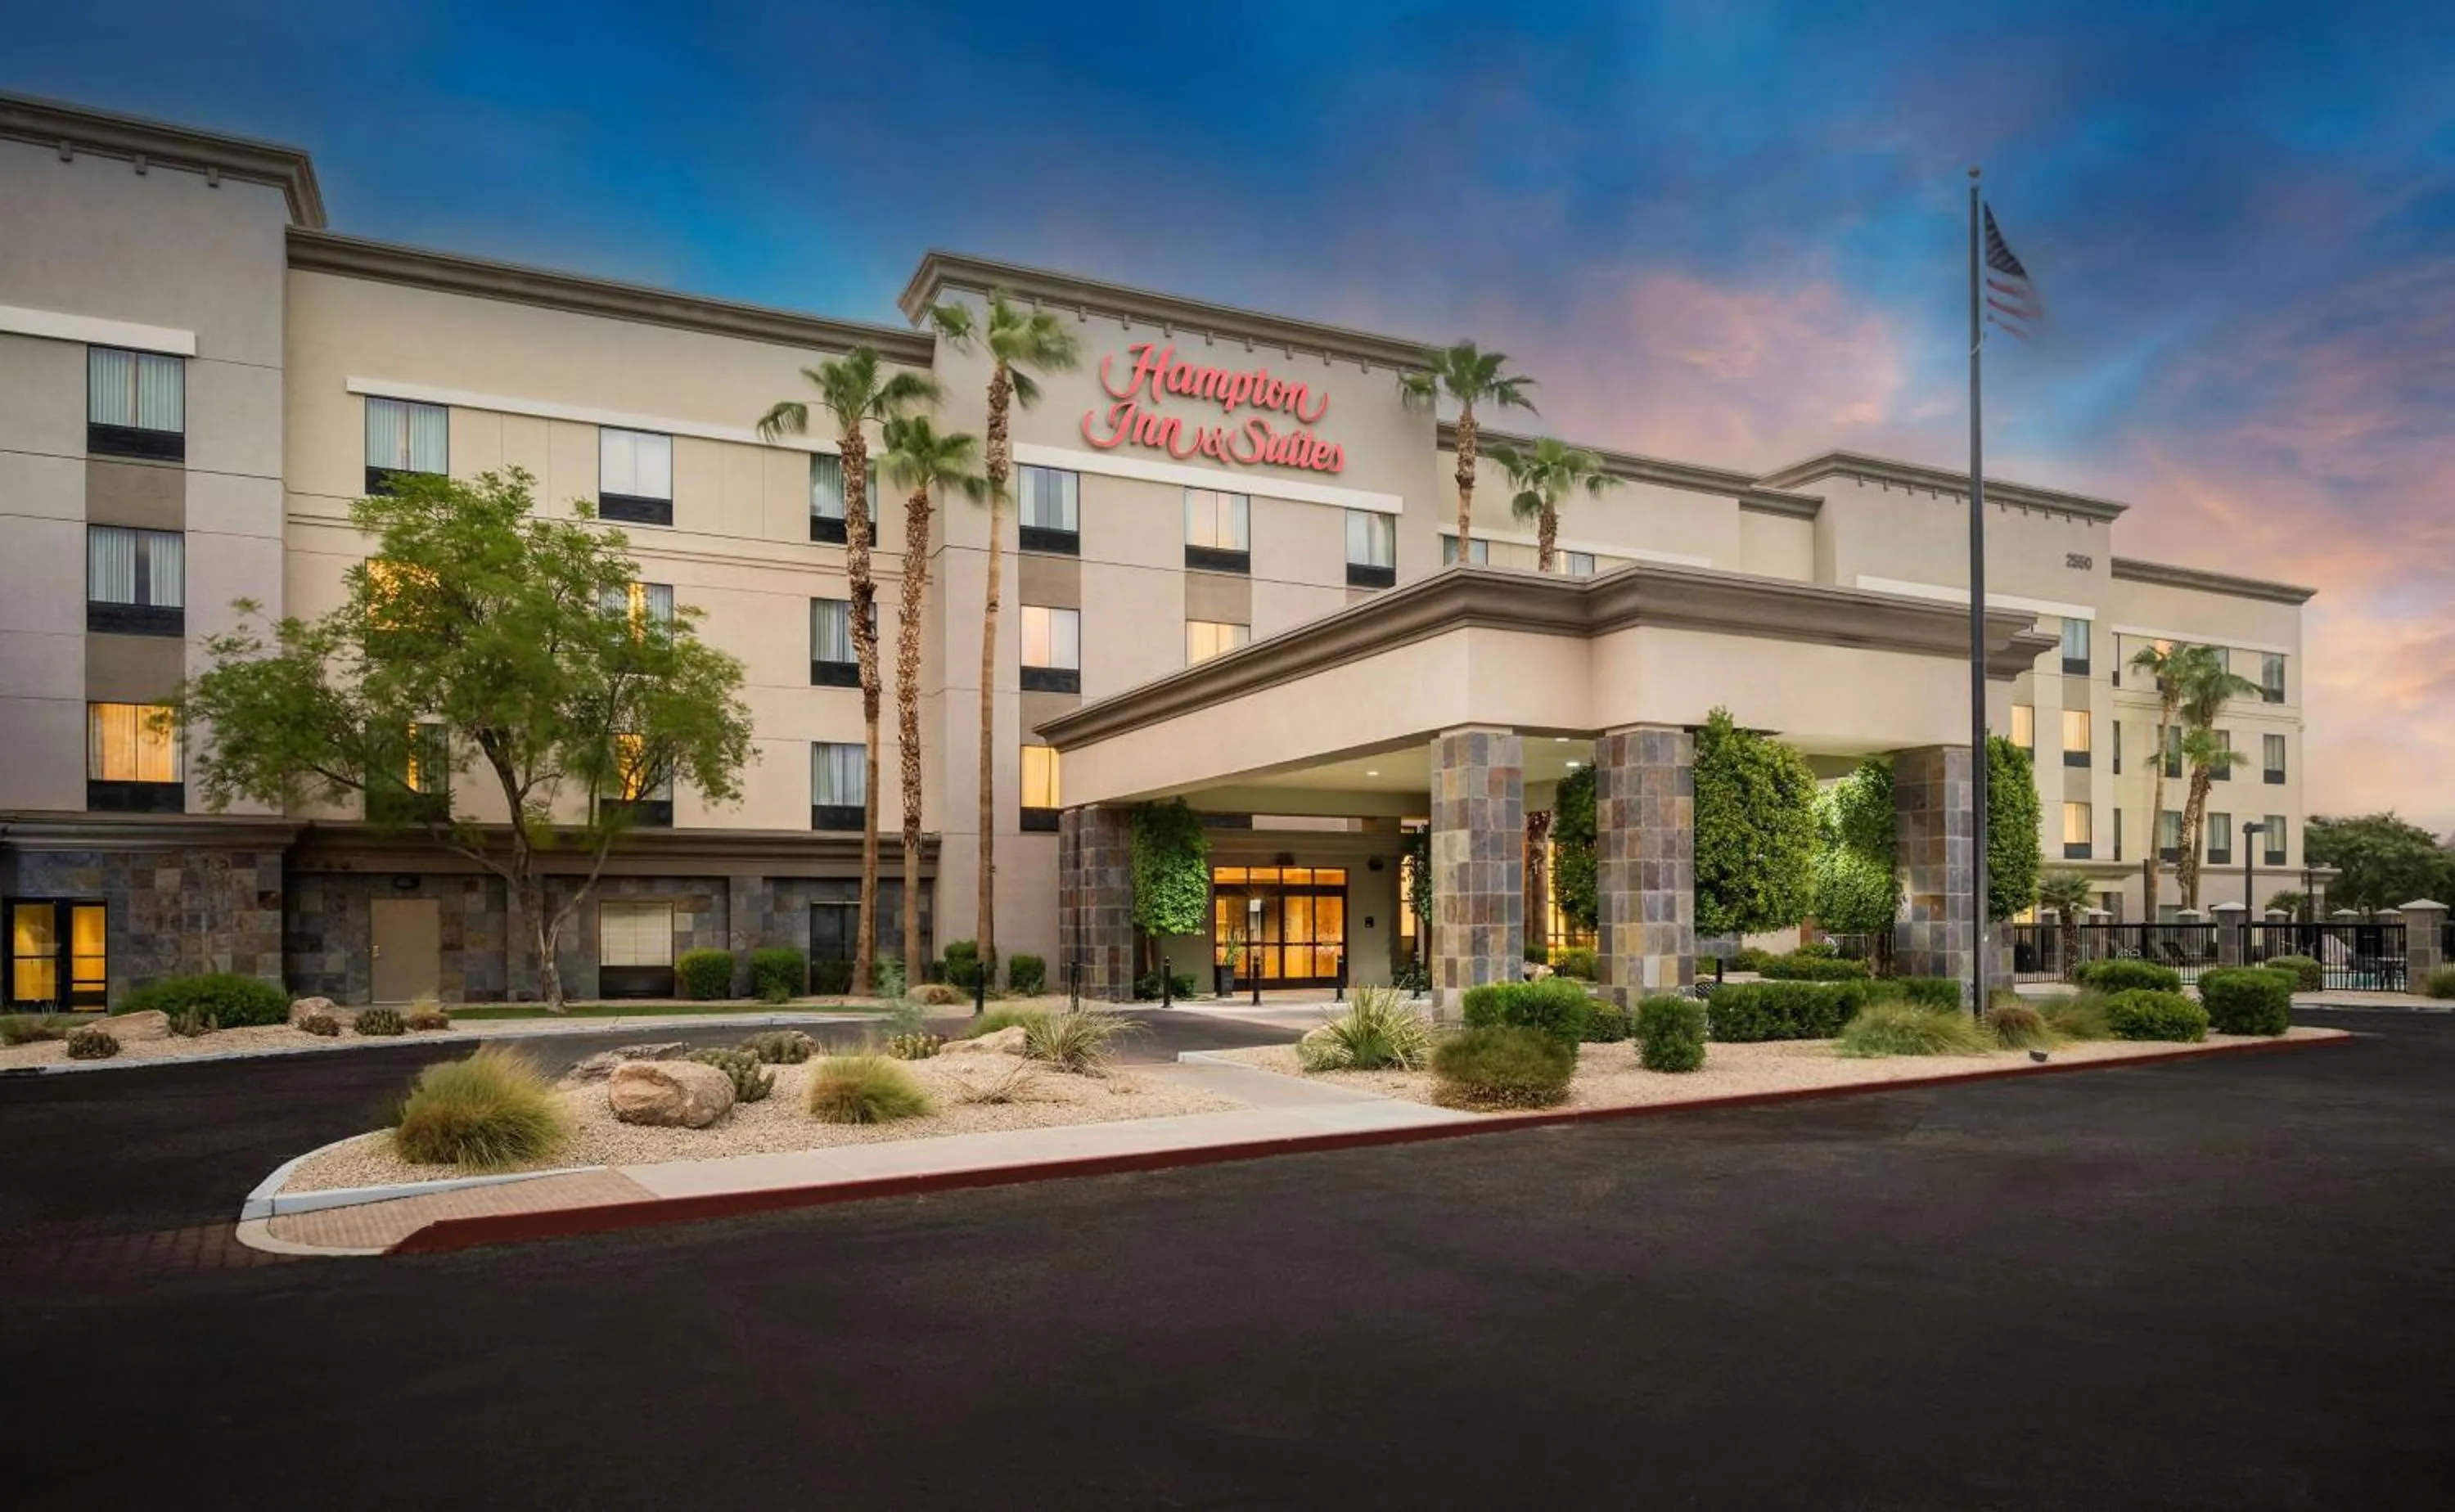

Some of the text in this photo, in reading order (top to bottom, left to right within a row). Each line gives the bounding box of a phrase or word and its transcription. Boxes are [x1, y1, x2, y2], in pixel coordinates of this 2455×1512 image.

[1102, 343, 1329, 423] Hampton
[1083, 401, 1345, 472] Inn & Suites
